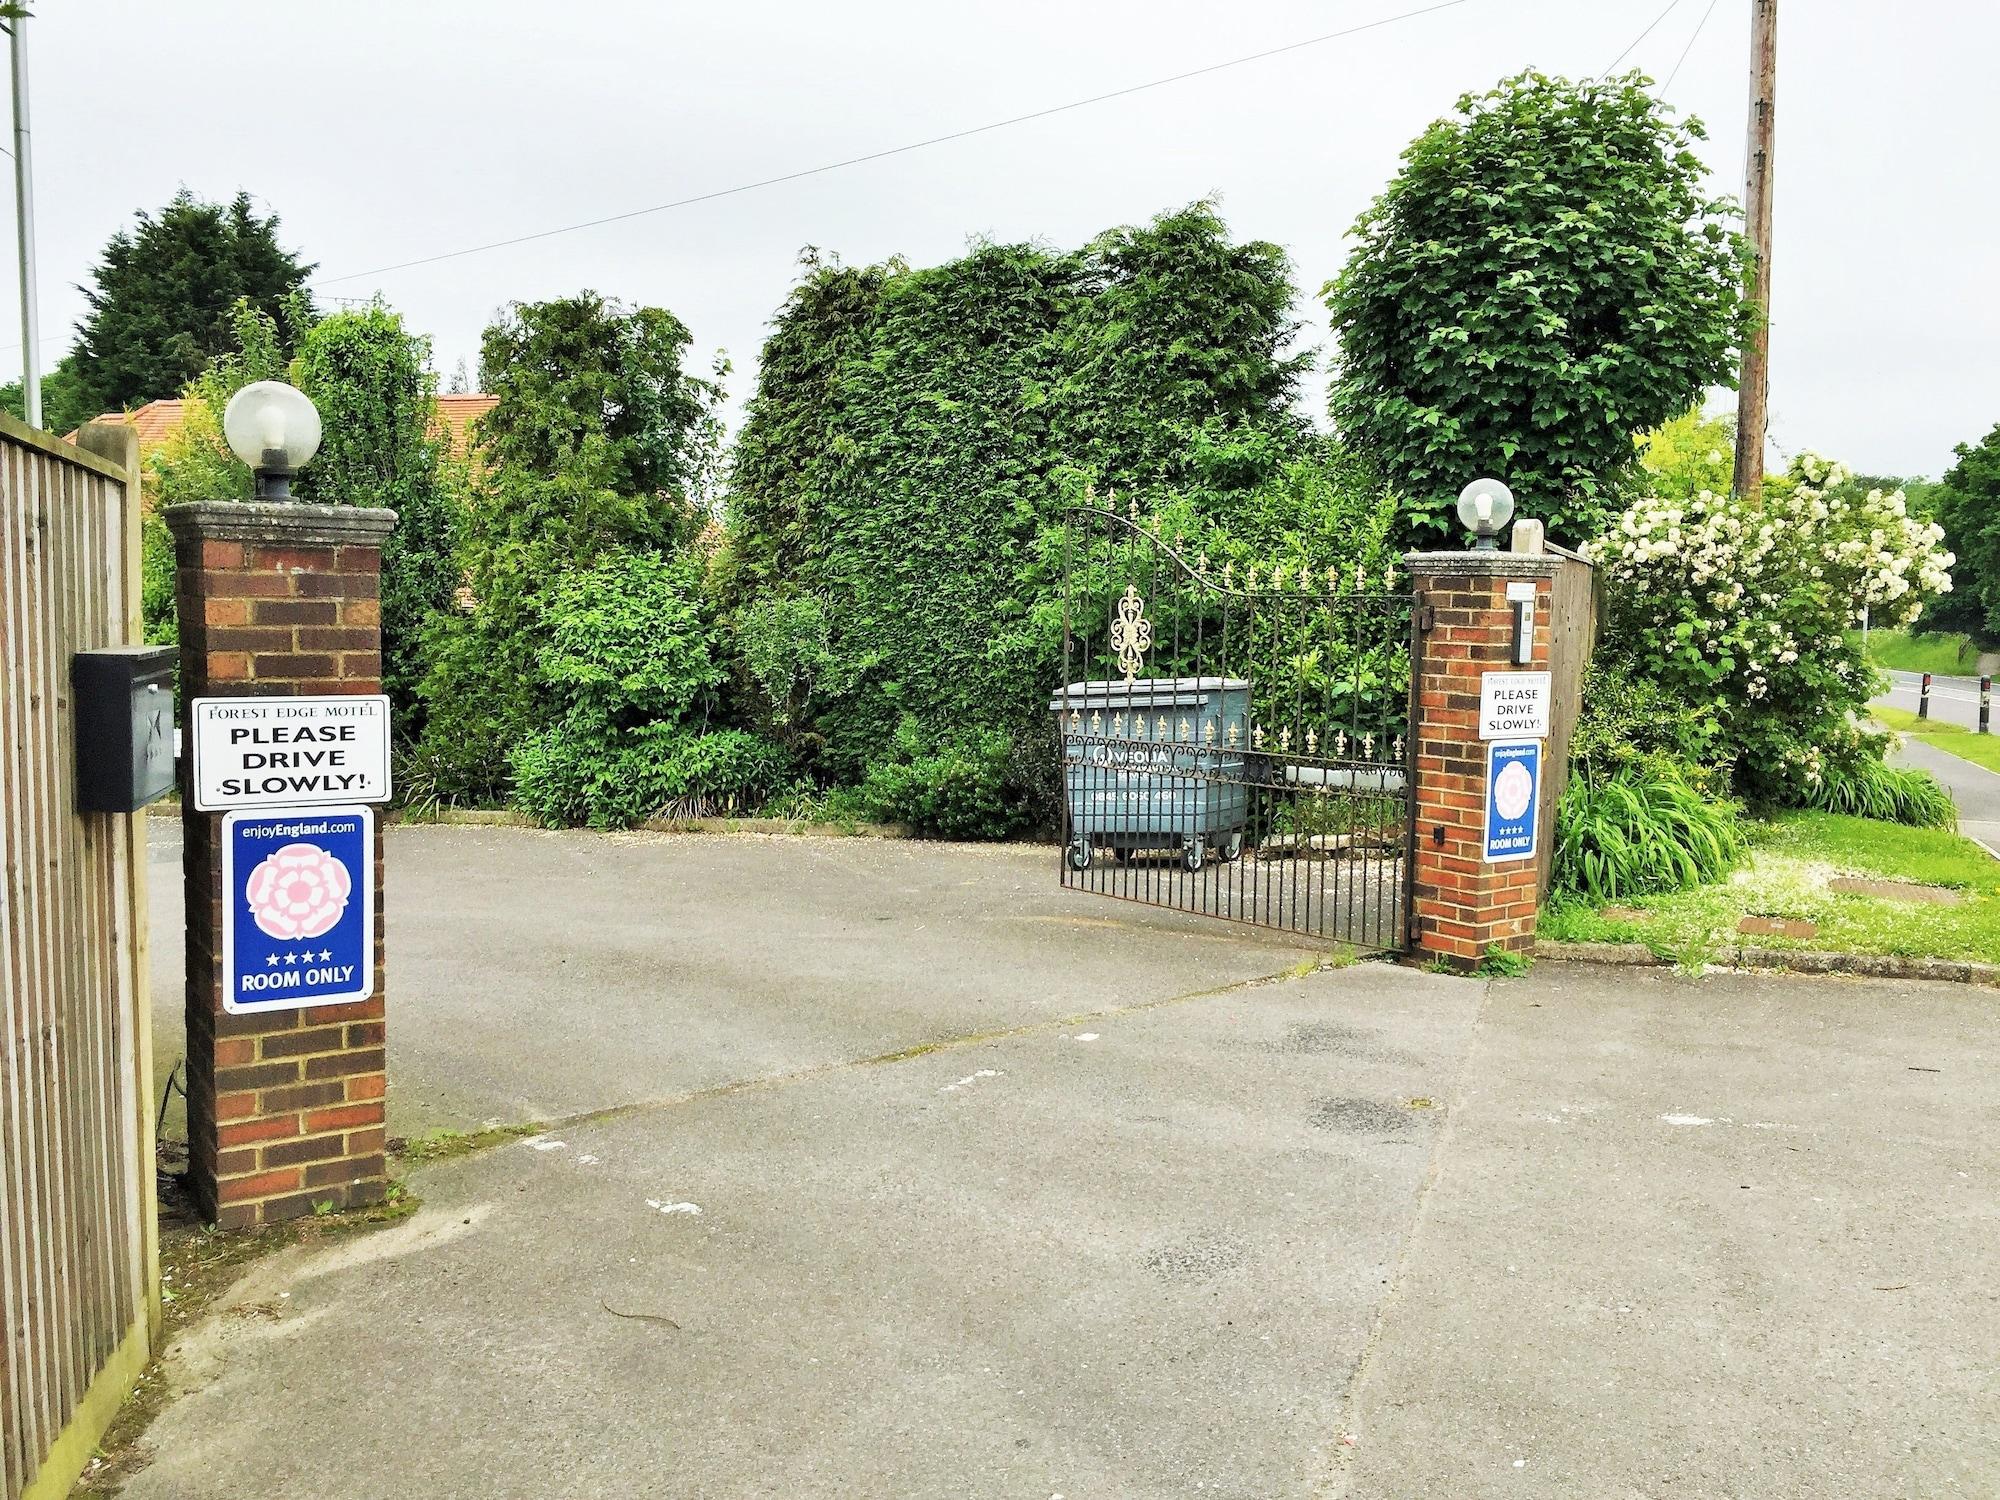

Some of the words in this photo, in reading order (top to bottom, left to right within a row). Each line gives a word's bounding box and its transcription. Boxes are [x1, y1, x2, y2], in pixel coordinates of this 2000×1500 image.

[1494, 689, 1538, 700] PLEASE
[209, 708, 269, 720] FOREST
[276, 707, 318, 718] EDGE
[325, 706, 378, 717] MOTEL
[1497, 704, 1533, 715] DRIVE
[1489, 719, 1540, 731] SLOWLY!
[231, 725, 356, 745] PLEASE
[243, 750, 345, 770] DRIVE
[1114, 750, 1168, 764] VEOLIA
[222, 773, 366, 796] SLOWLY!
[242, 821, 355, 840] enjoyEngland.com
[1490, 838, 1512, 850] ROOM
[1512, 835, 1531, 848] ONLY
[242, 970, 301, 992] ROOM
[305, 965, 354, 986] ONLY
